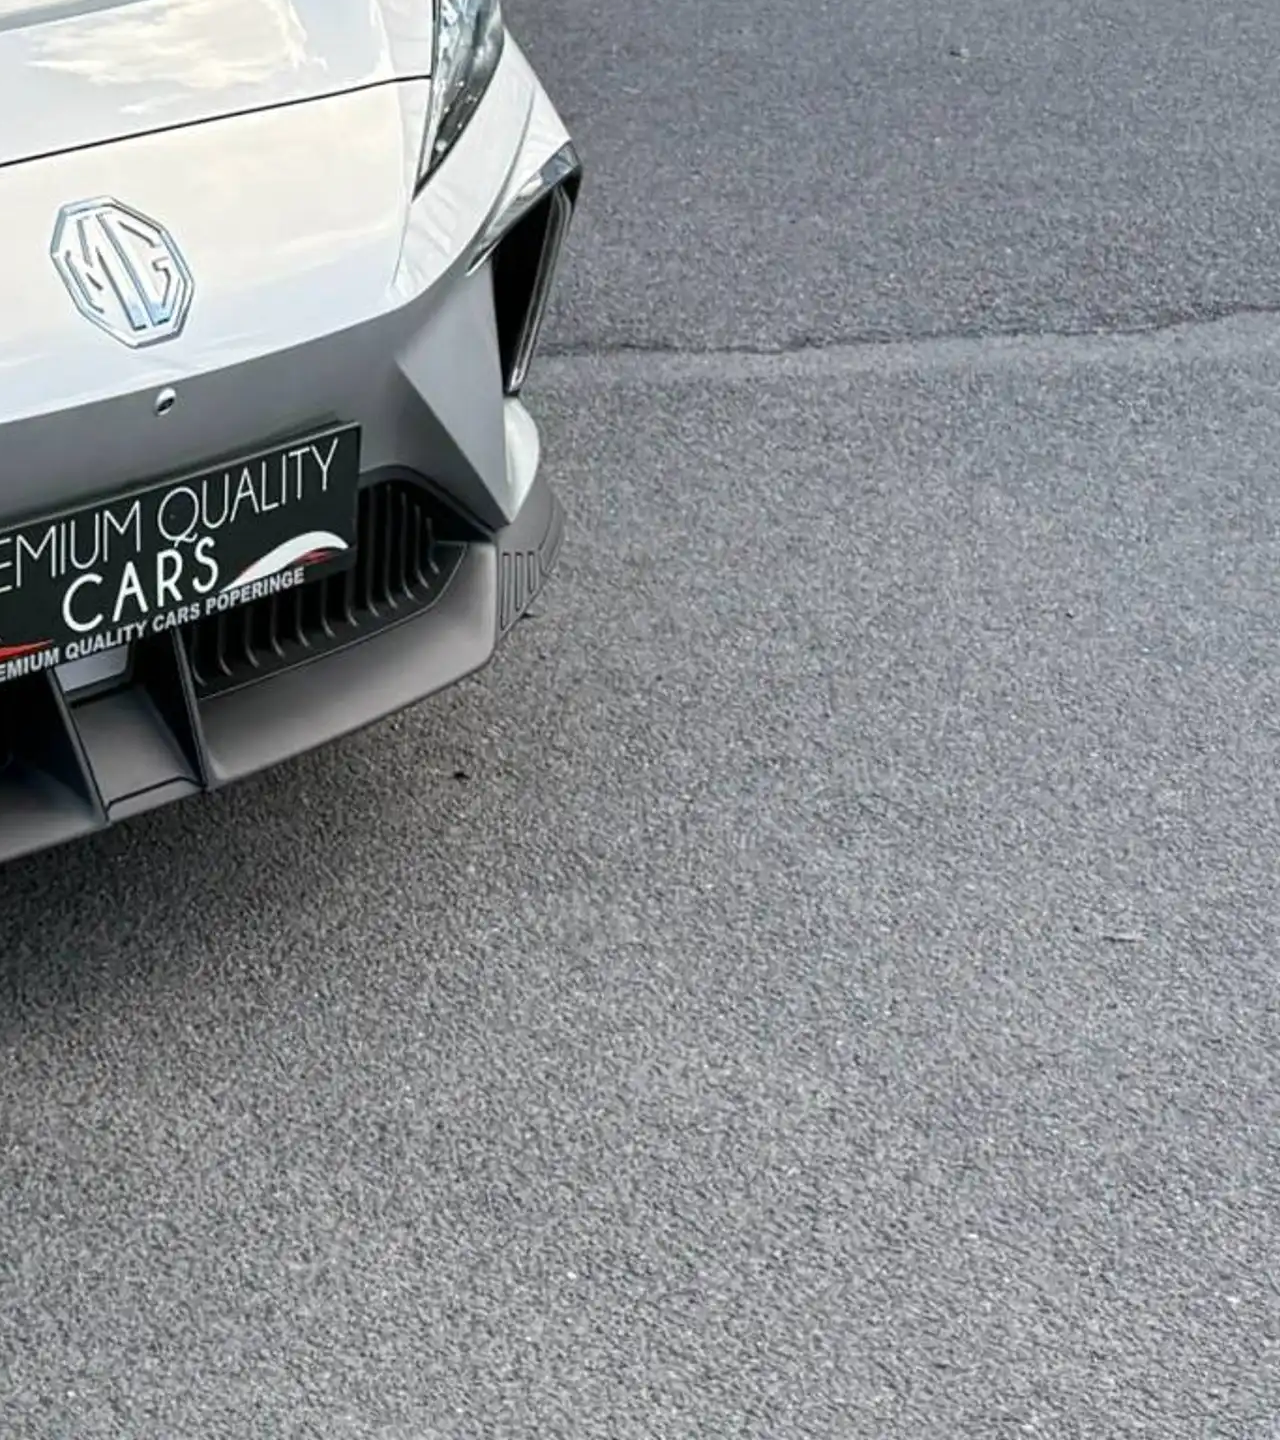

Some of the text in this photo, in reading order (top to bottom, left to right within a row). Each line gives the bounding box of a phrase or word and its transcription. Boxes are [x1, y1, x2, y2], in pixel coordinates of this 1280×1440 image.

[58, 205, 182, 338] MG
[156, 436, 339, 549] QUALITY
[61, 535, 220, 633] CARS
[64, 619, 147, 660] QUALITY
[151, 602, 201, 633] CARS
[204, 565, 305, 616] POPERINGE
